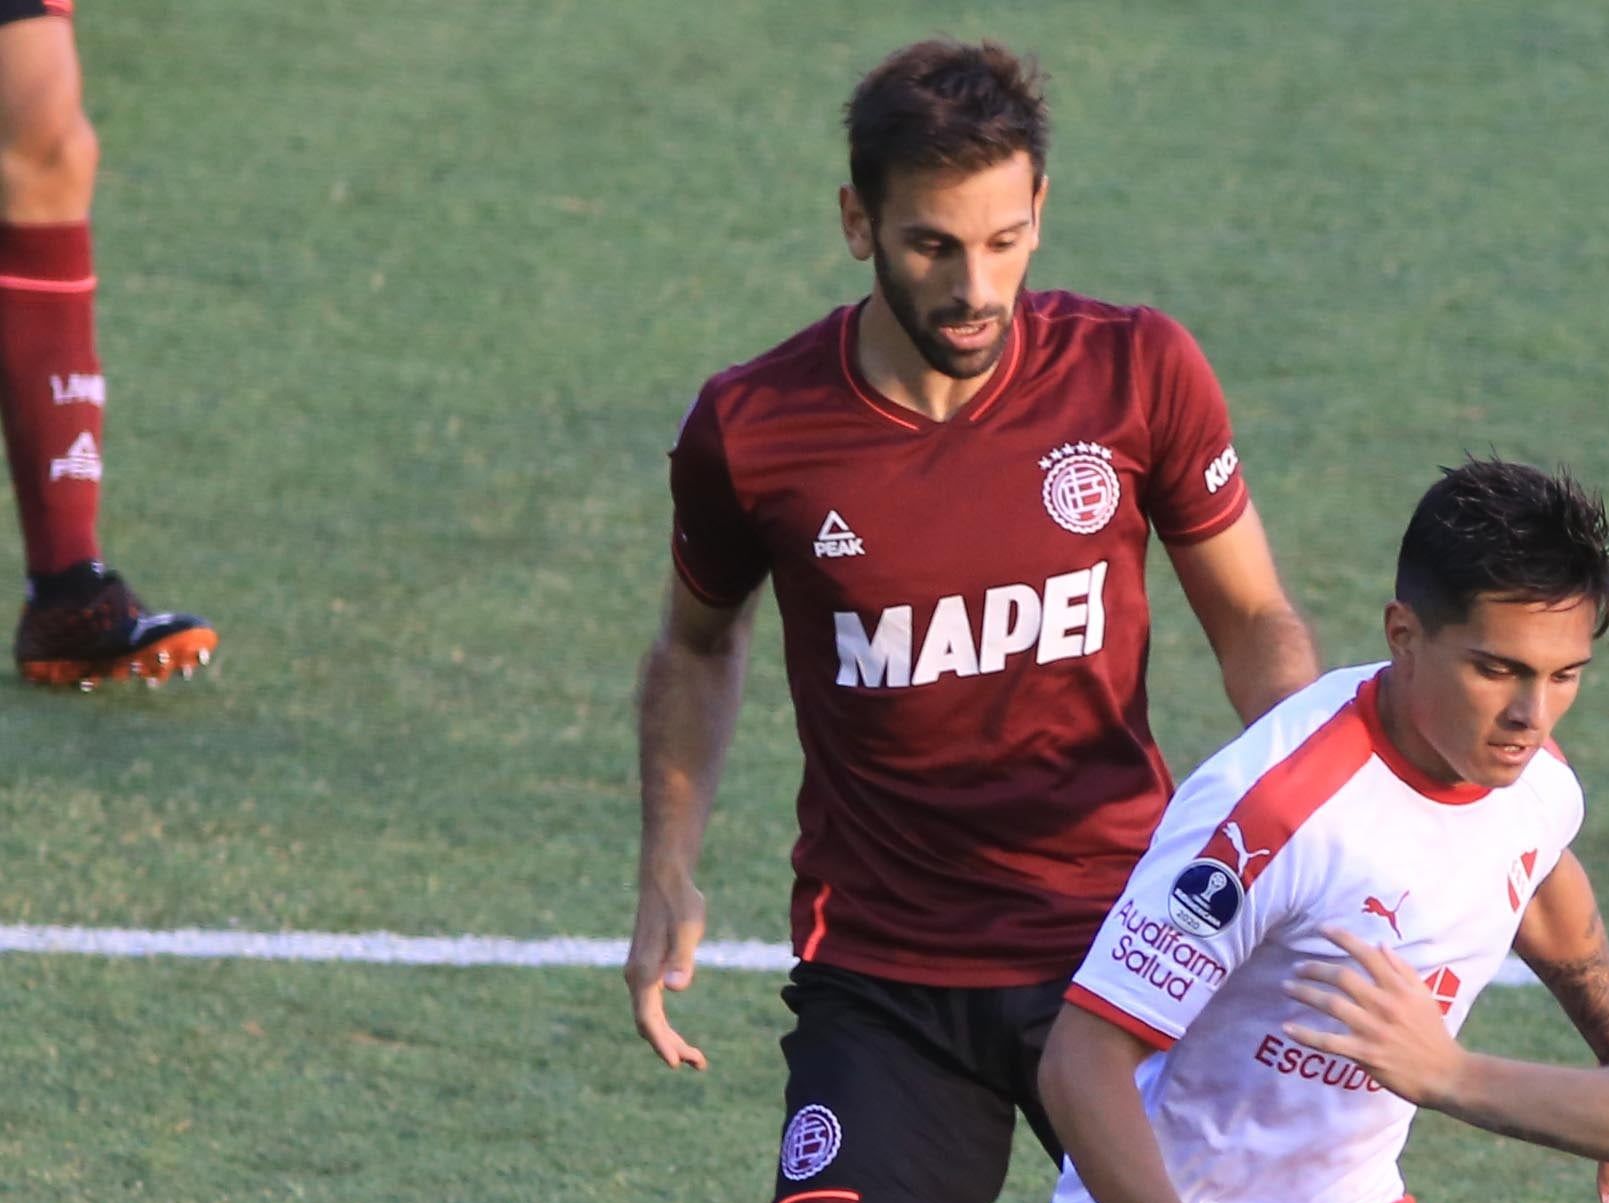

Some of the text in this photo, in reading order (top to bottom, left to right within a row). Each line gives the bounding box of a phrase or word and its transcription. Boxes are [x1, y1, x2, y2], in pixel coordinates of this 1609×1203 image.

[1204, 444, 1239, 494] KIO
[813, 537, 866, 558] PEAK
[833, 561, 1108, 688] MAPEI
[1114, 897, 1229, 988] Audifarm
[1176, 909, 1201, 930] 2020
[1111, 934, 1195, 1002] Salud
